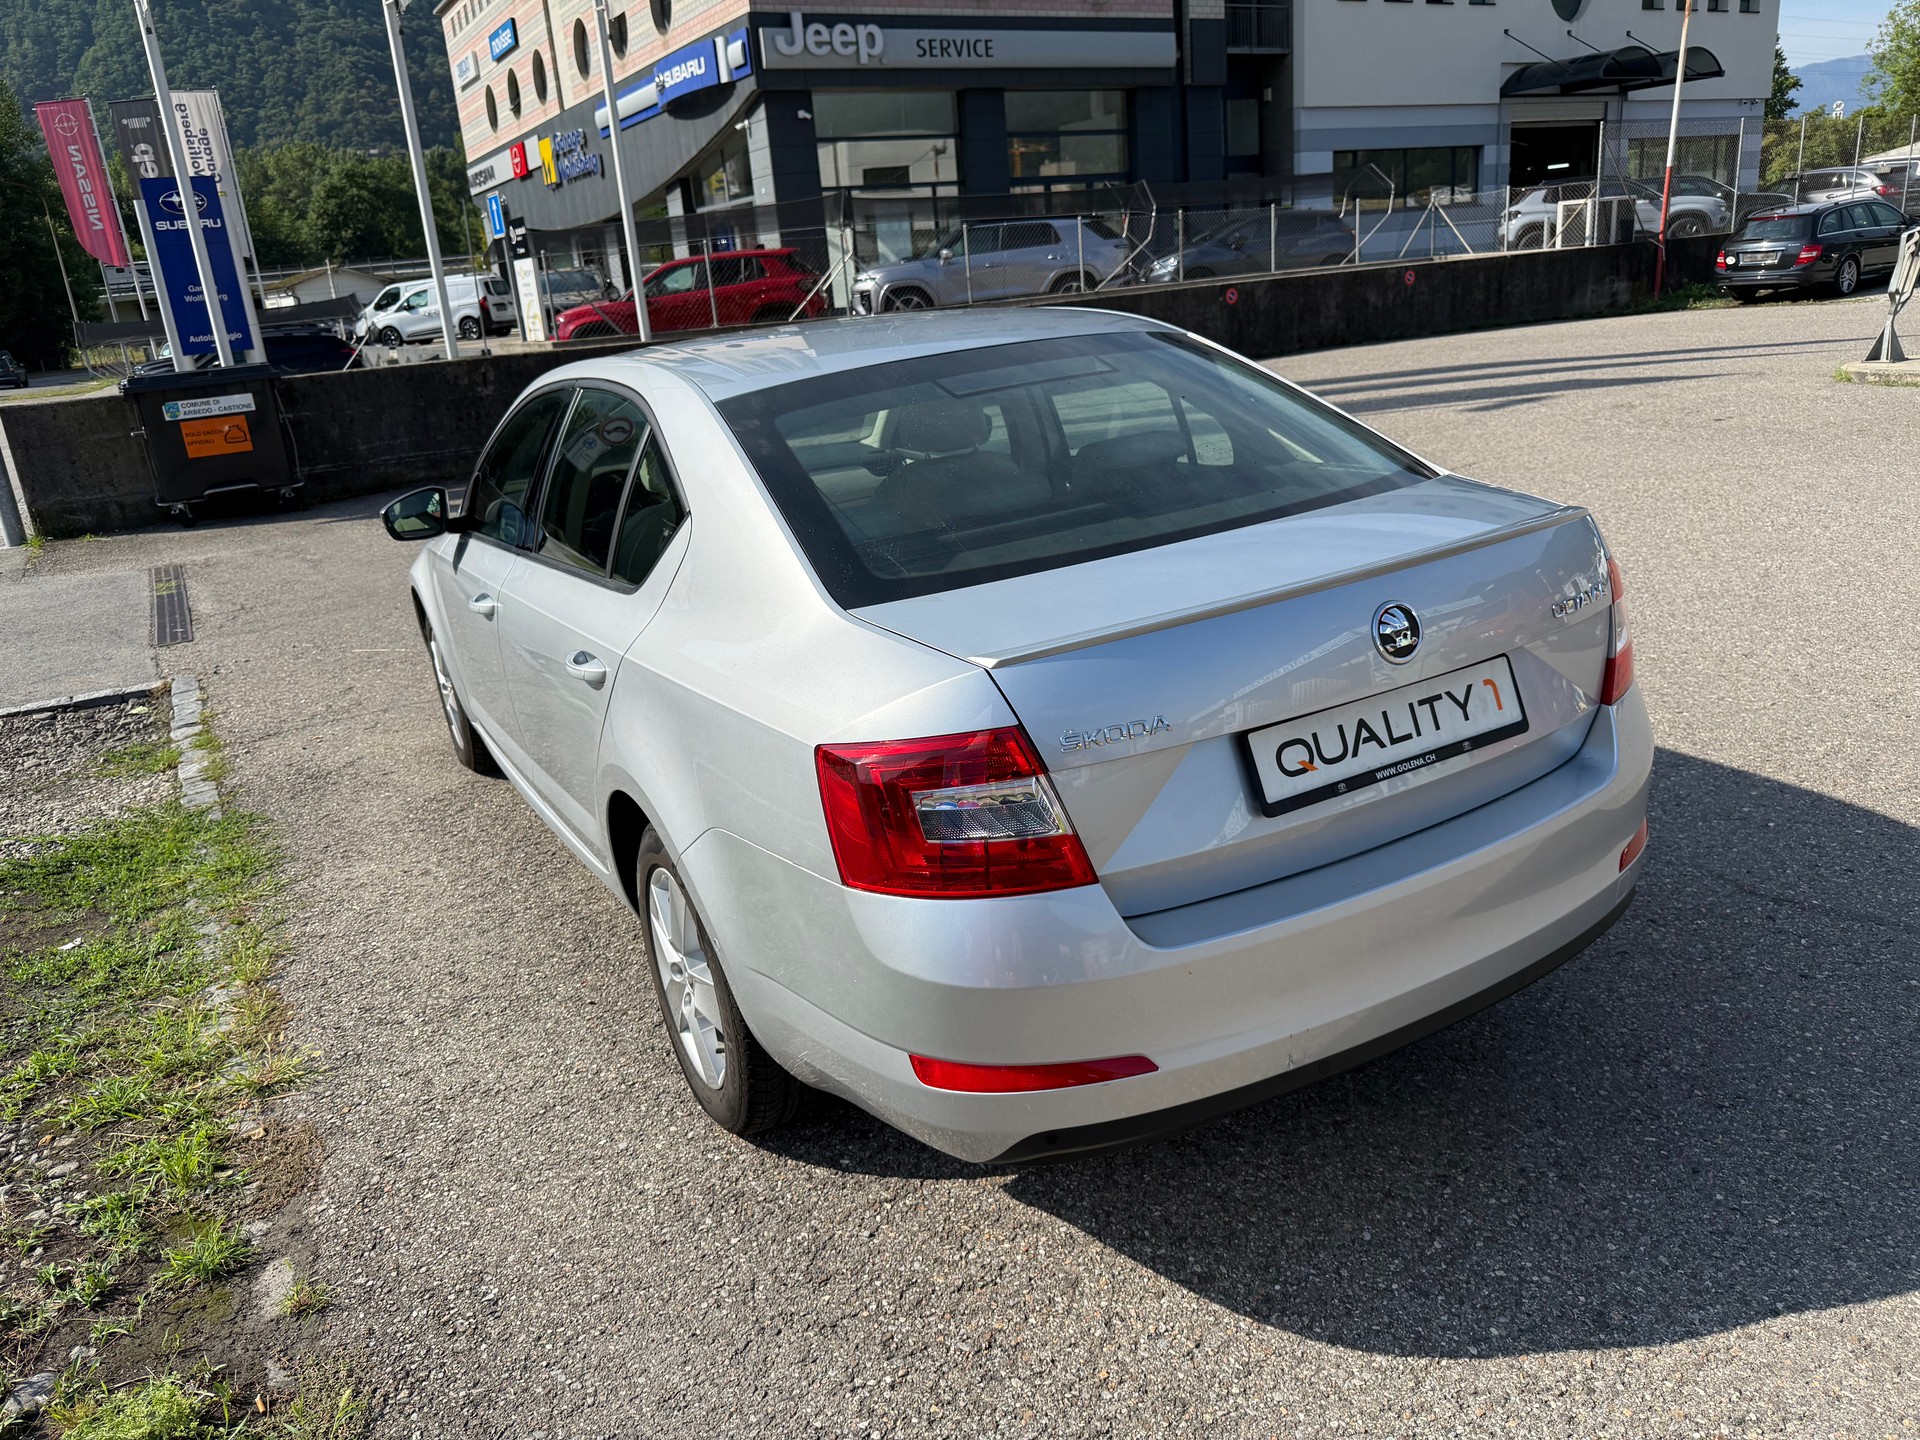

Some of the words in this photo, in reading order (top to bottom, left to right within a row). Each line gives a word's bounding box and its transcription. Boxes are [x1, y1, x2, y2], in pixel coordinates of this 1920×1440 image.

[774, 11, 884, 65] Jeep
[916, 38, 994, 58] SERVICE
[663, 56, 706, 88] SUBARU
[553, 128, 583, 154] Garage
[155, 218, 222, 231] SUBRU
[183, 293, 228, 303] Wolfirg
[180, 400, 212, 409] COMUNE
[183, 408, 213, 417] ARBEDO
[218, 402, 253, 412] CASTIONE
[185, 430, 201, 438] SOLO
[1059, 714, 1173, 754] ŠKODA
[1275, 683, 1473, 778] QUALITY
[1482, 678, 1503, 711] 1
[1375, 753, 1437, 780] WWW.GOLENA.CH
